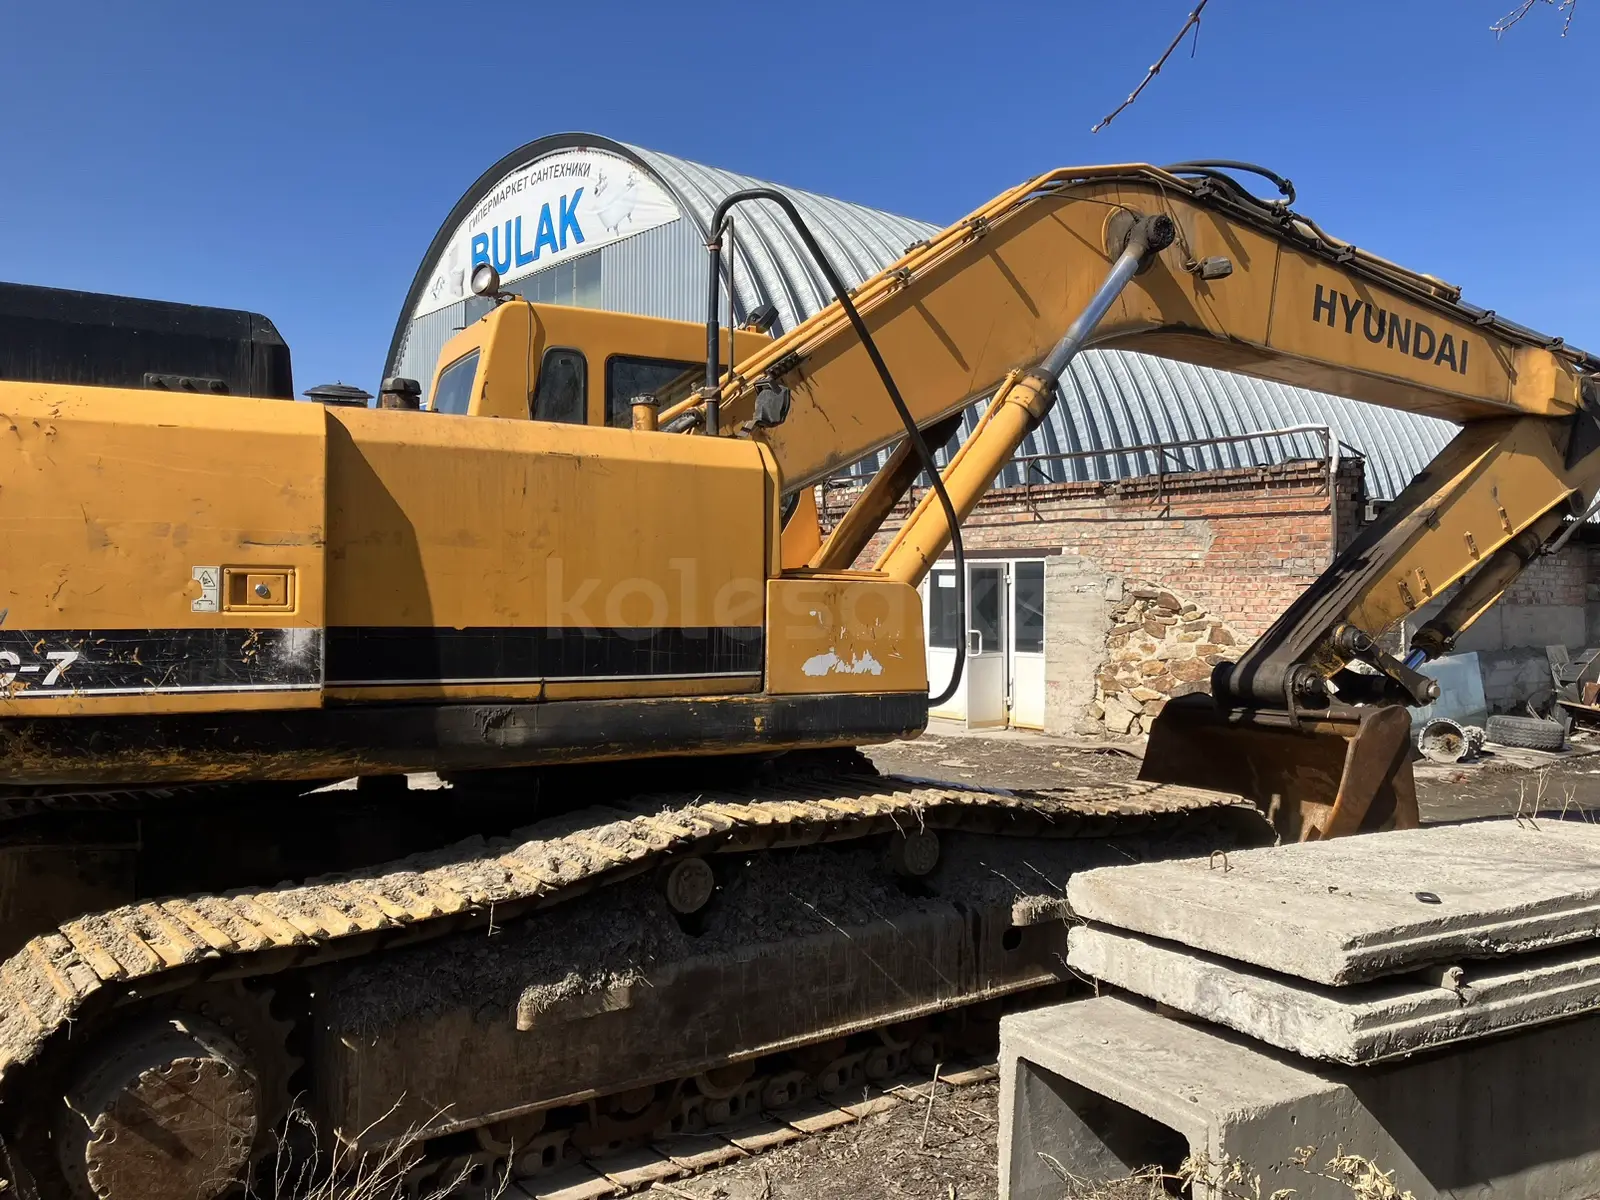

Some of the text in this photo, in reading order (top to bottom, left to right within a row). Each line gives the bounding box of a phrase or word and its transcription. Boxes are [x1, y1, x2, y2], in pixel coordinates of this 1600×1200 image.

[468, 163, 591, 233] ГИПЕРМАРКЕТ САНТЕХНИКИ
[471, 187, 585, 276] BULAK
[1313, 284, 1468, 375] HYUNDAI
